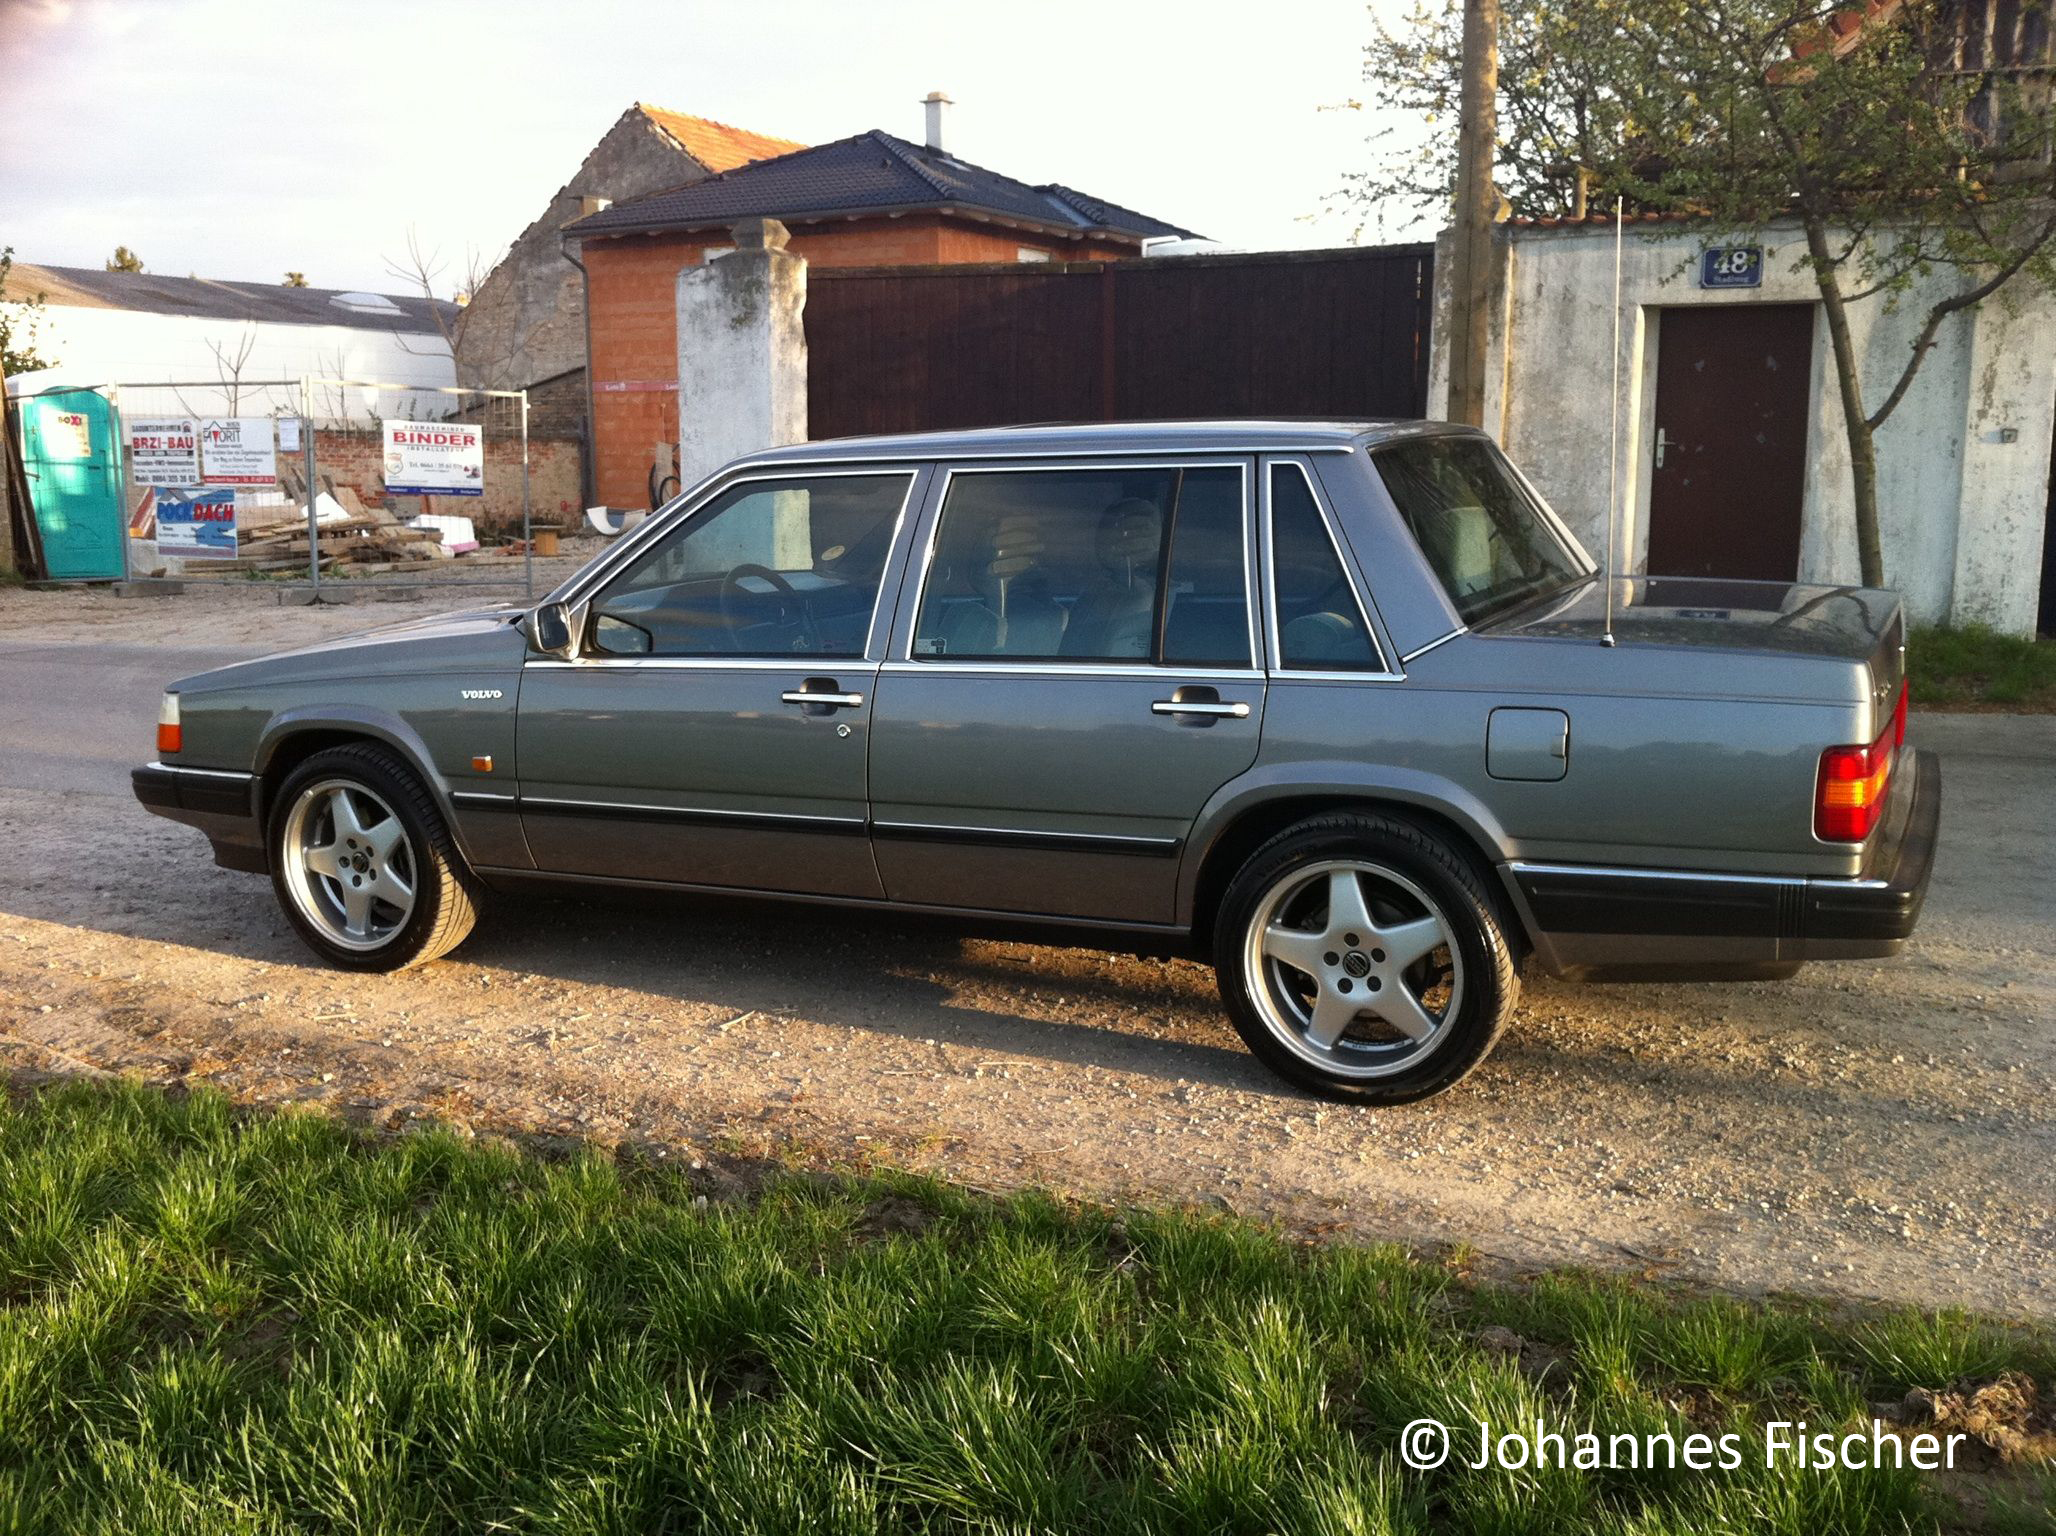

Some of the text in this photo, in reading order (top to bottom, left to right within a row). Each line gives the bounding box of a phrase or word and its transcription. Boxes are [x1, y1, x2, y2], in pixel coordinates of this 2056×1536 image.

[1713, 251, 1748, 274] 48
[132, 437, 194, 449] BRZI-BAU
[393, 432, 476, 446] BINDER
[193, 502, 235, 522] DACH
[461, 690, 503, 699] VOLVO
